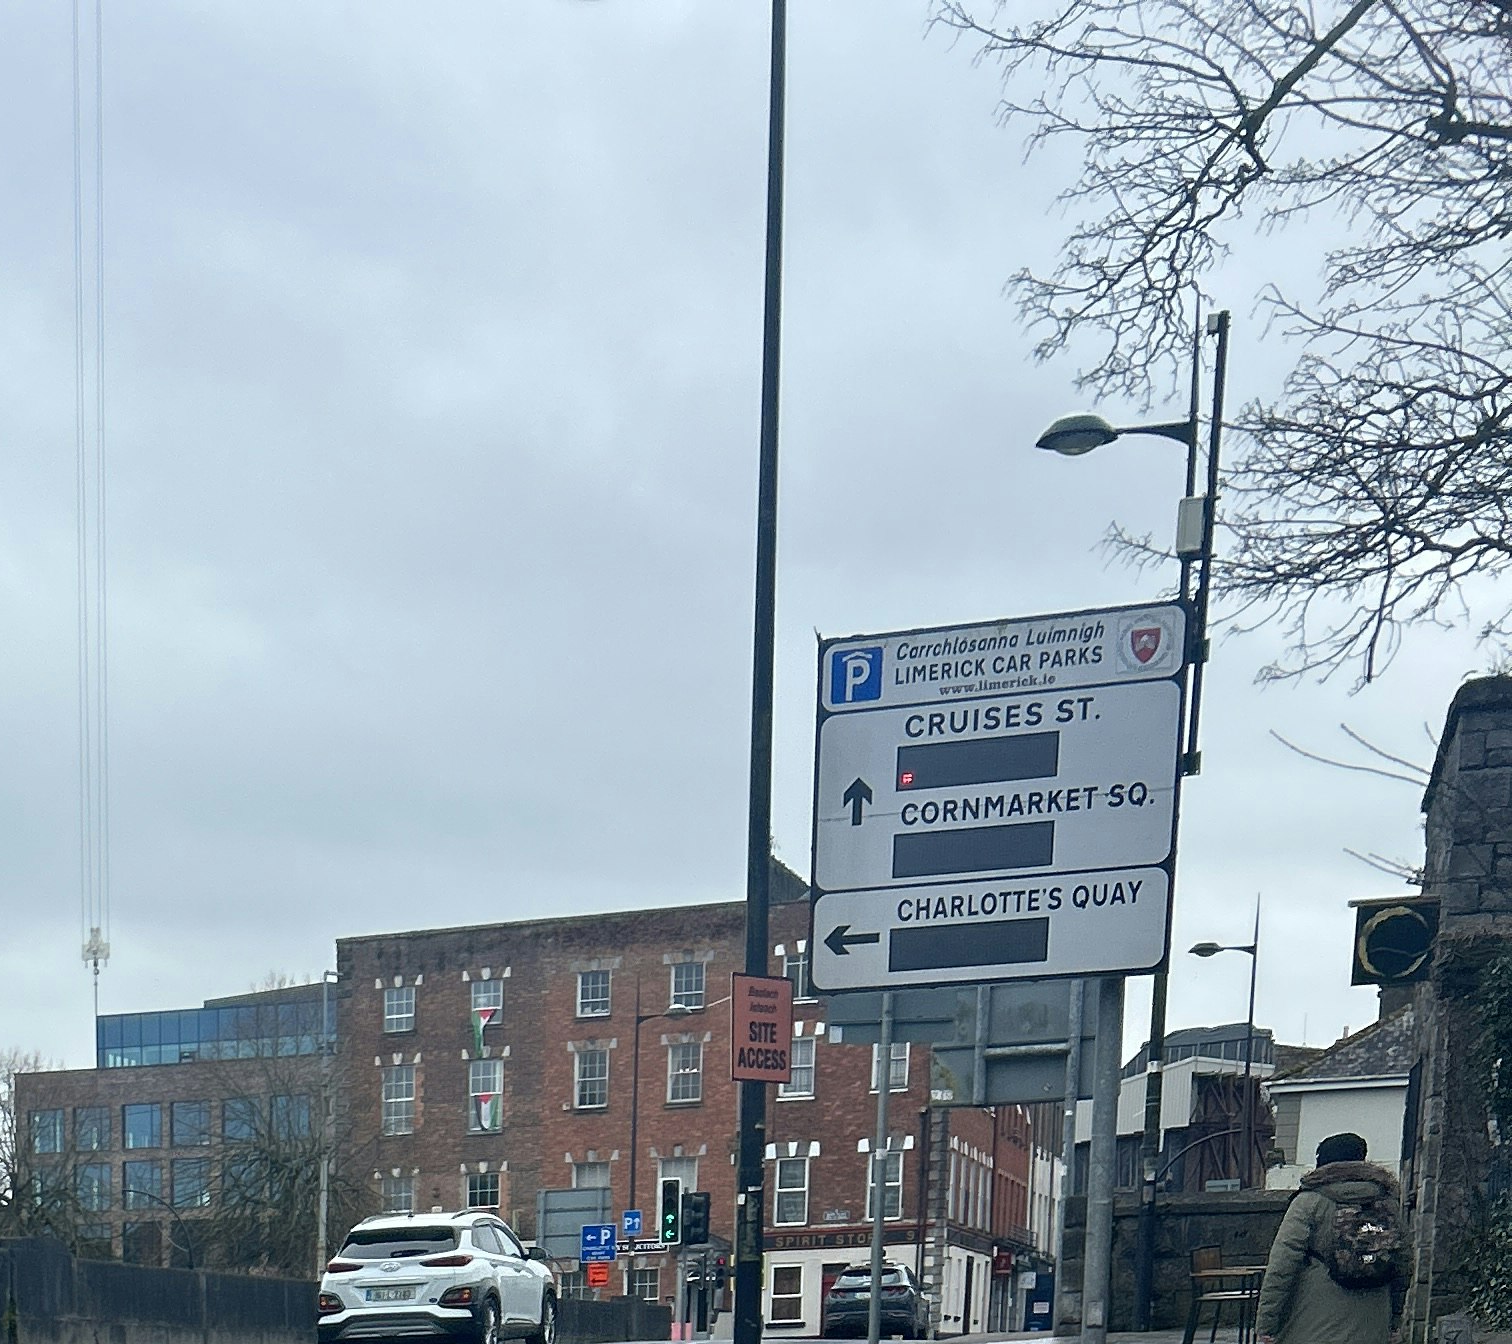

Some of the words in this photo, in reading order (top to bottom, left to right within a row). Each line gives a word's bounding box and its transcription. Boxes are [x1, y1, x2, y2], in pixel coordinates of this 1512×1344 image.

[895, 657, 986, 685] LIMERICK
[992, 653, 1032, 674] CAR
[1039, 645, 1103, 669] PARKS
[846, 659, 870, 701] P
[939, 673, 1056, 696] www.limerick.ie
[905, 702, 1043, 738] CRUISES
[1055, 697, 1101, 723] ST.
[901, 786, 1098, 826] CORNMARKET
[1107, 781, 1155, 808] SQ.
[897, 887, 1063, 922] CHARLOTTE'S
[1072, 880, 1143, 910] QUAY
[749, 1021, 777, 1043] SITE
[738, 1047, 786, 1070] ACCESS
[624, 1217, 633, 1230] P
[600, 1229, 611, 1245] P
[775, 1234, 826, 1248] SPIRIT
